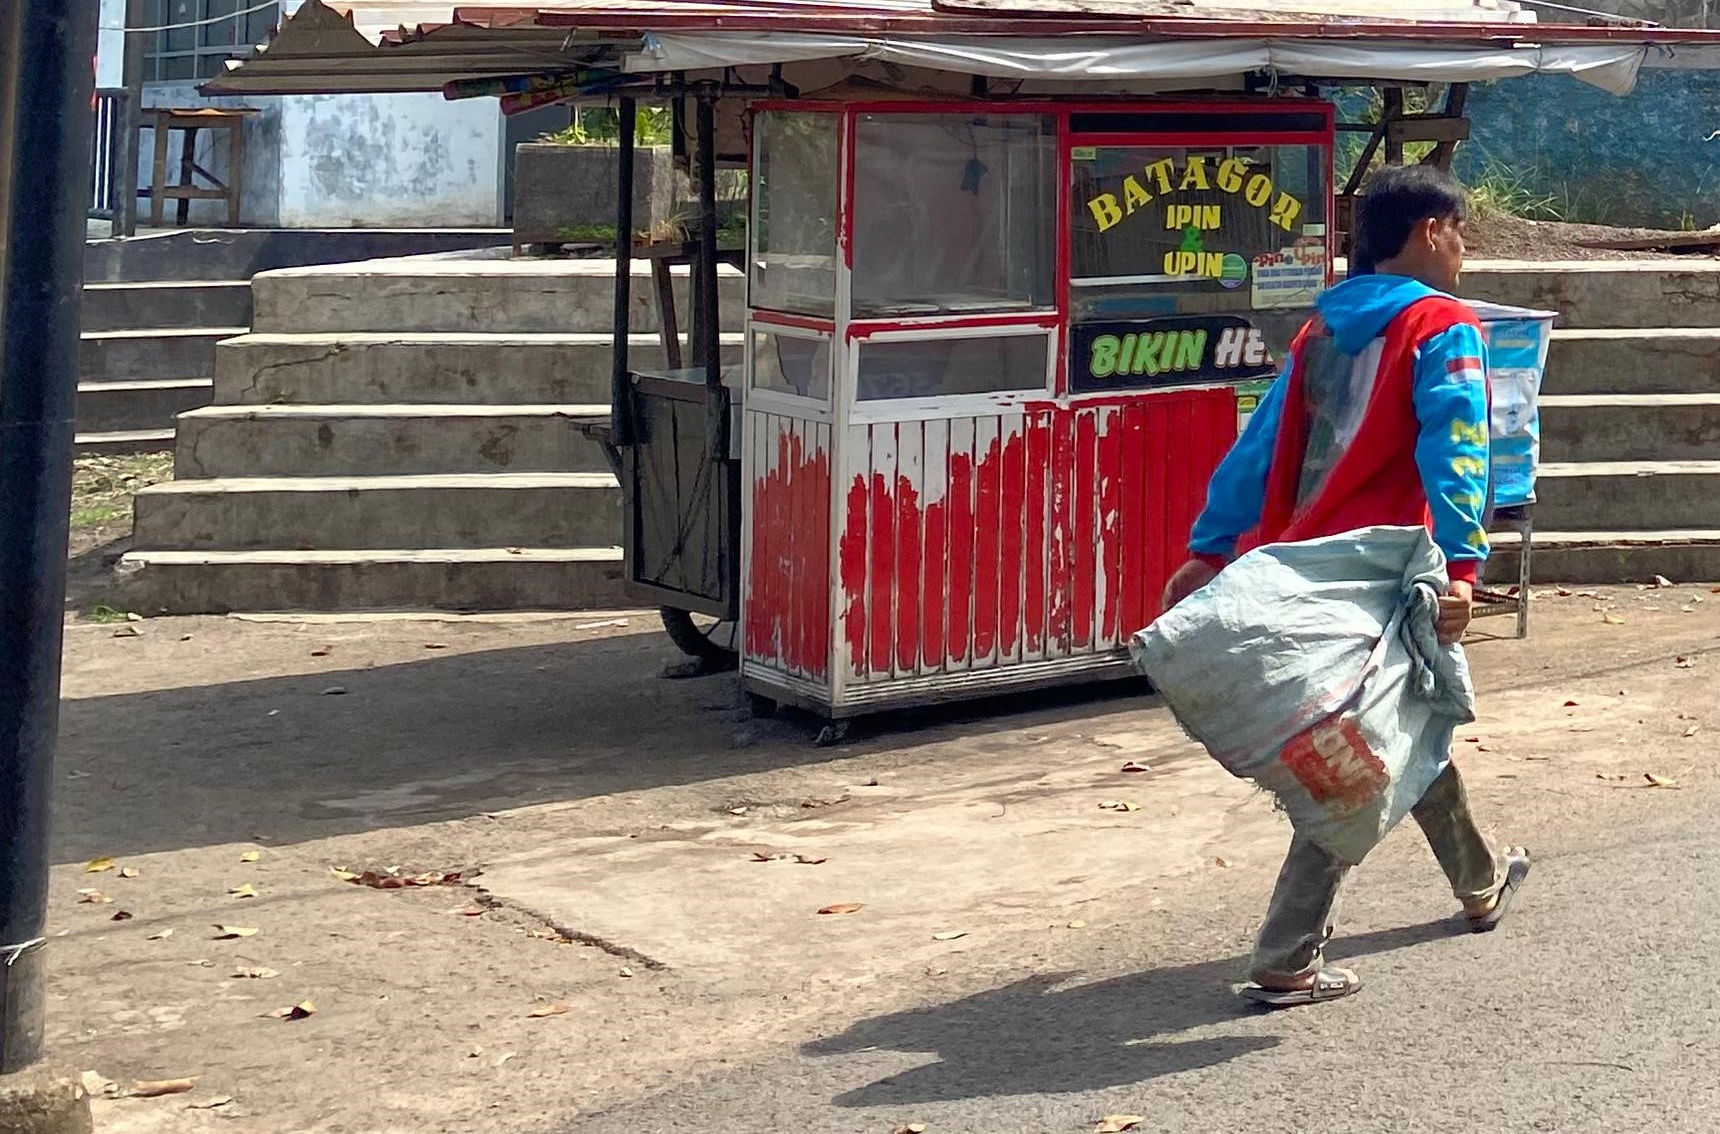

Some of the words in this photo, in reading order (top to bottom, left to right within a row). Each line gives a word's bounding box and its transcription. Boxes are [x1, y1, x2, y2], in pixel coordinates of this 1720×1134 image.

[1087, 156, 1302, 233] BATAGOR
[1165, 204, 1221, 231] IPIN
[1164, 251, 1224, 278] UPIN
[1090, 329, 1207, 377] BIKIN
